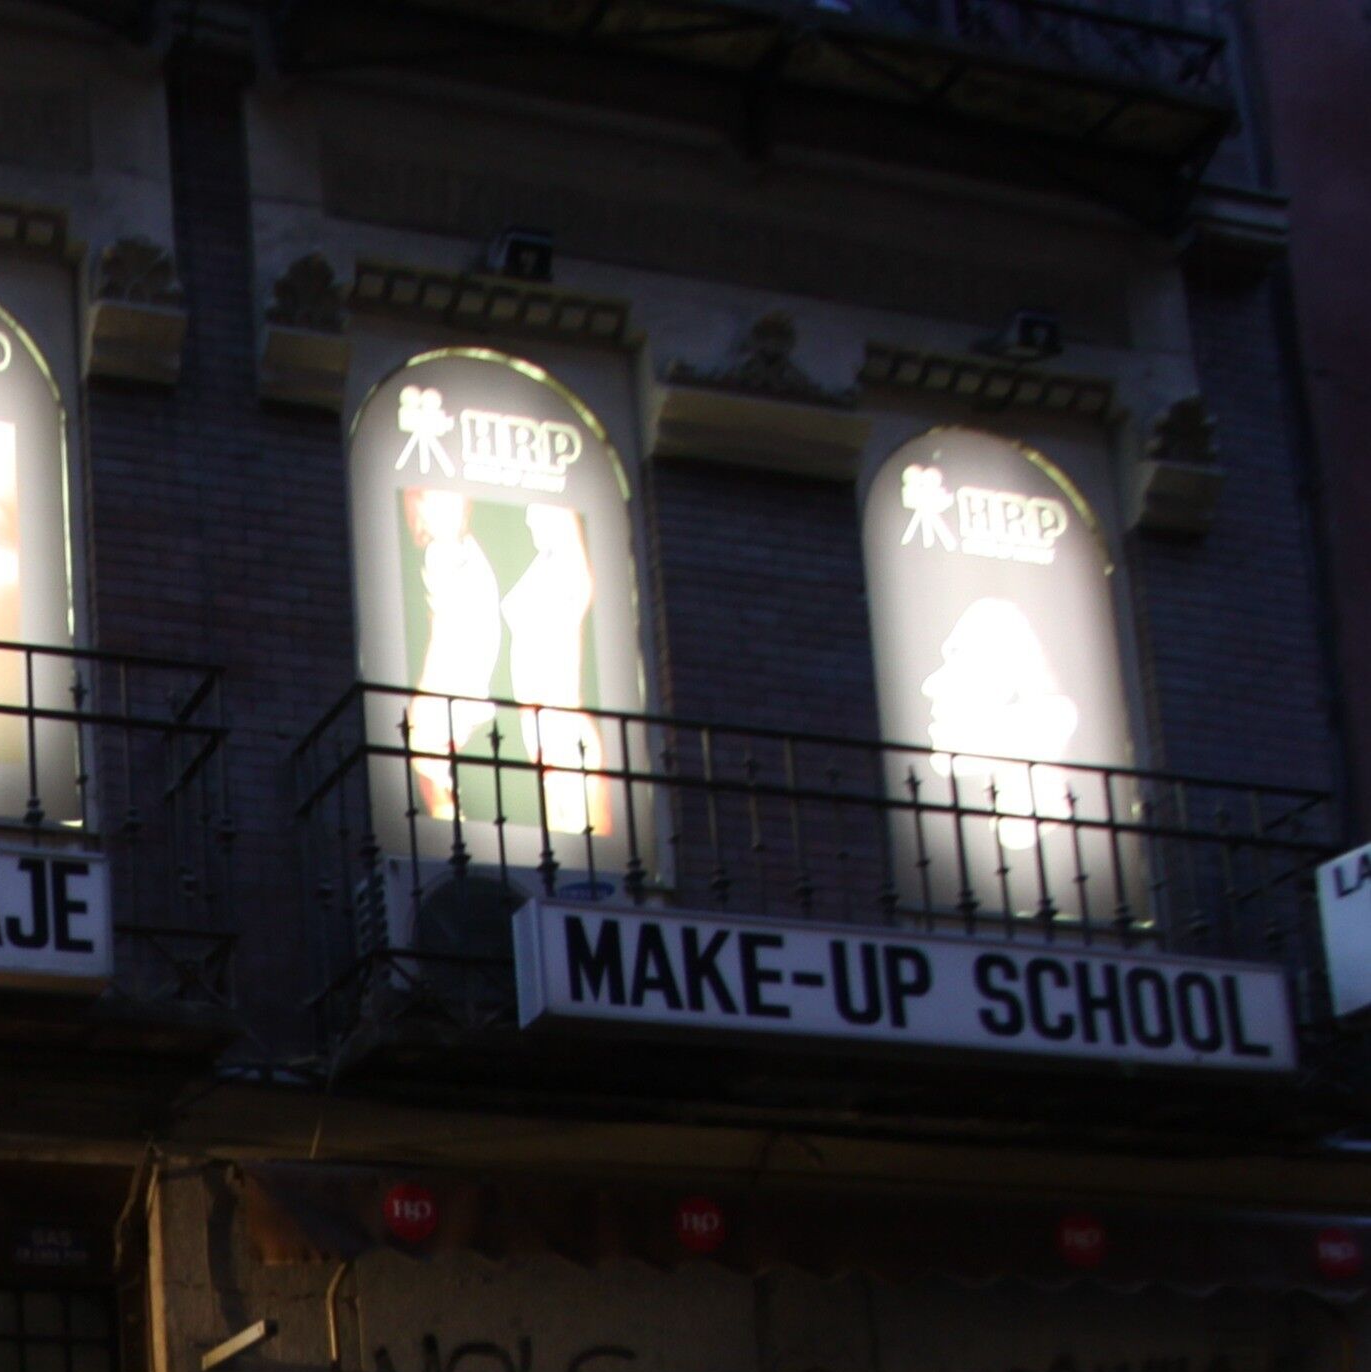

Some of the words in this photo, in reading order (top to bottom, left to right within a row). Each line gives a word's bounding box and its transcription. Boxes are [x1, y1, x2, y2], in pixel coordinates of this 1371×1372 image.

[460, 409, 581, 476] HRP
[564, 915, 932, 1029] MAKE-UP
[974, 953, 1272, 1058] SCHOOL
